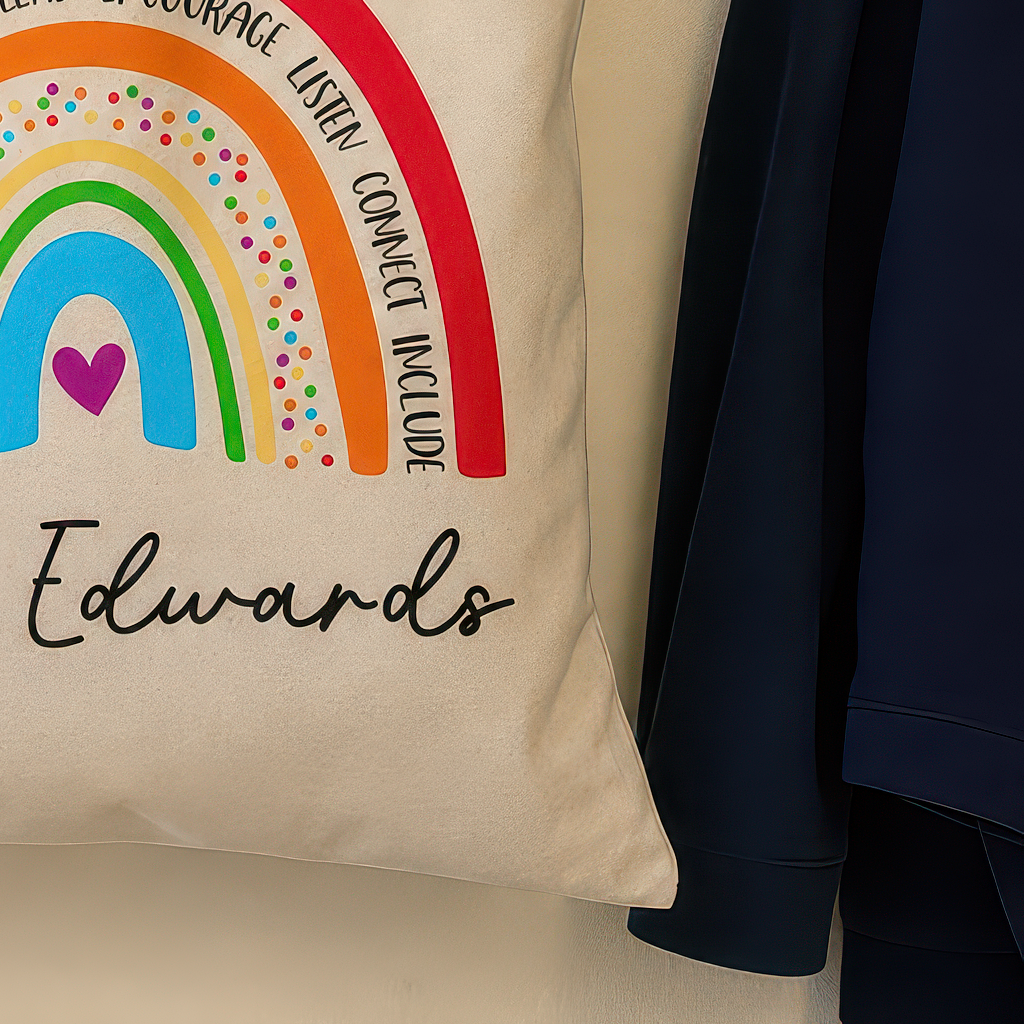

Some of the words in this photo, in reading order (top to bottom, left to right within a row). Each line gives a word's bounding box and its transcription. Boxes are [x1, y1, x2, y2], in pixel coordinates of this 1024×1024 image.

[285, 54, 369, 152] LISTEN
[351, 170, 429, 313] CONNECT
[390, 333, 446, 475] INCLUDE
[27, 519, 516, 649] Edwards
